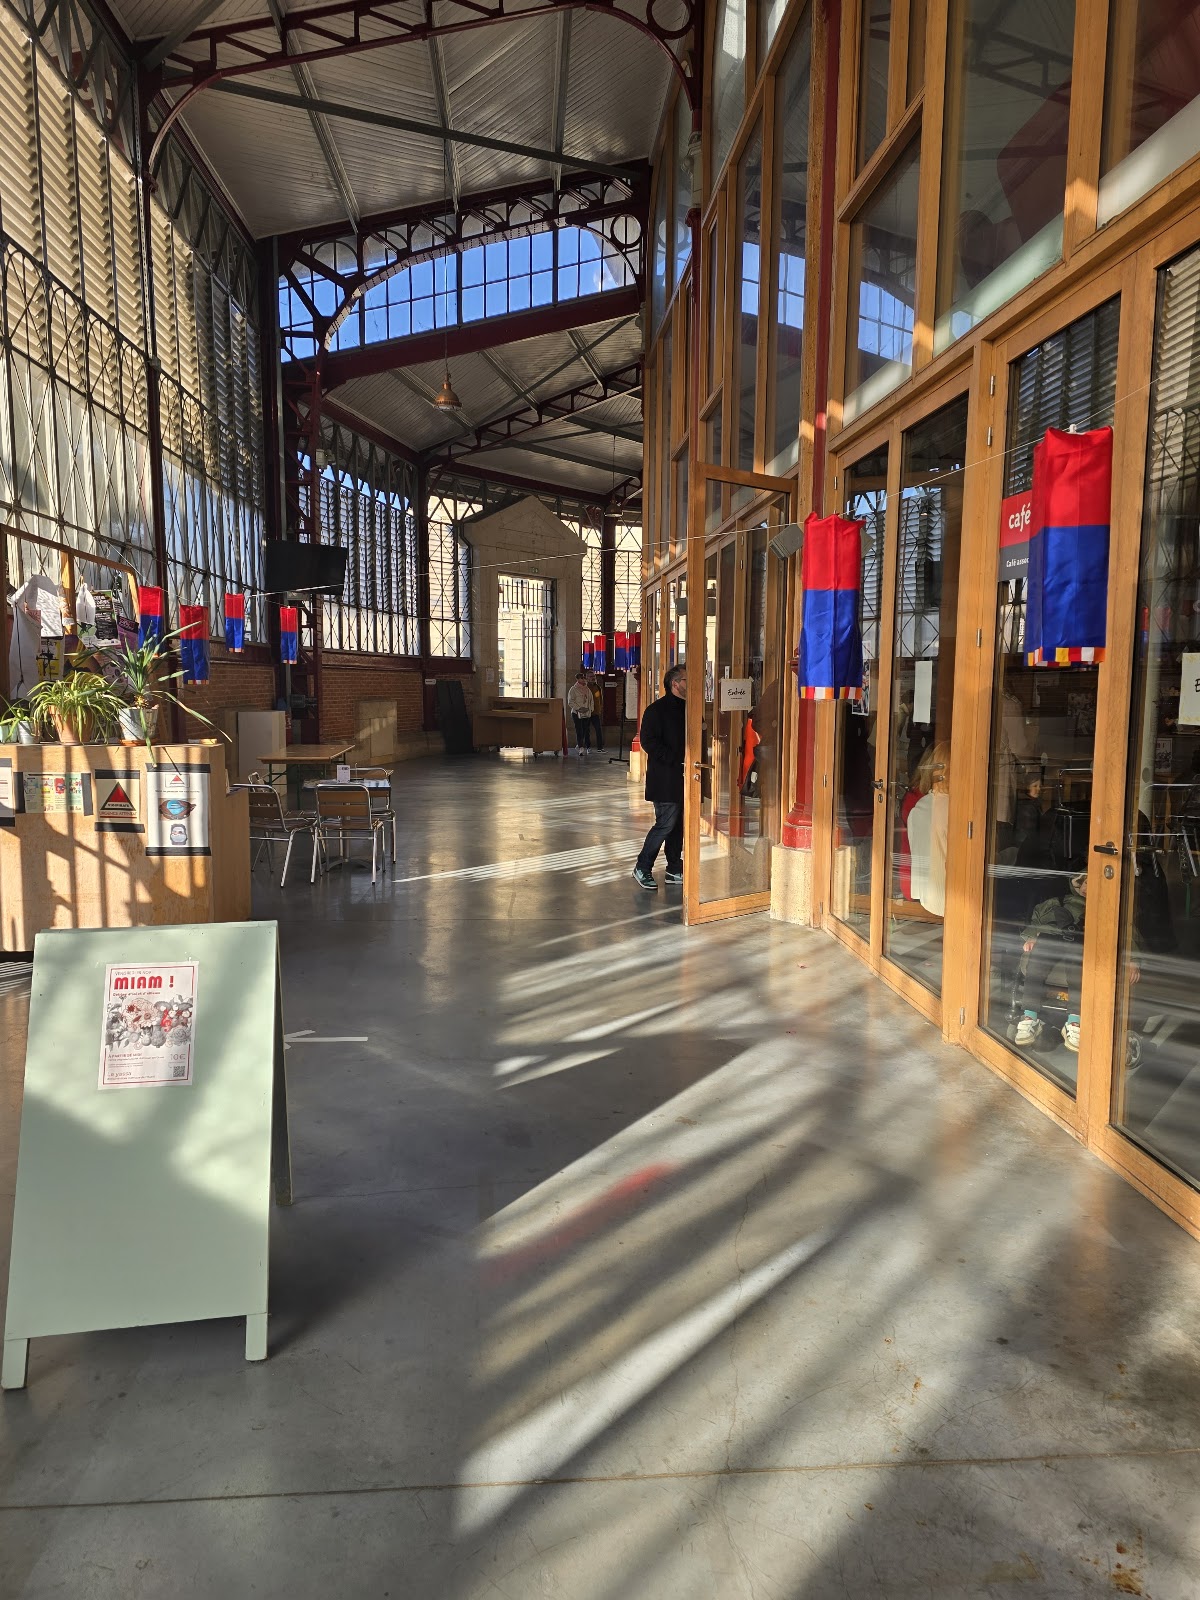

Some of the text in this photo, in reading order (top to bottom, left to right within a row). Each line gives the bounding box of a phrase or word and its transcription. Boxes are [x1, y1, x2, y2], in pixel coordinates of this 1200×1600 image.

[1008, 502, 1031, 532] café
[1006, 558, 1017, 568] Café
[727, 687, 746, 697] Entrée
[114, 975, 174, 990] MIAM !
